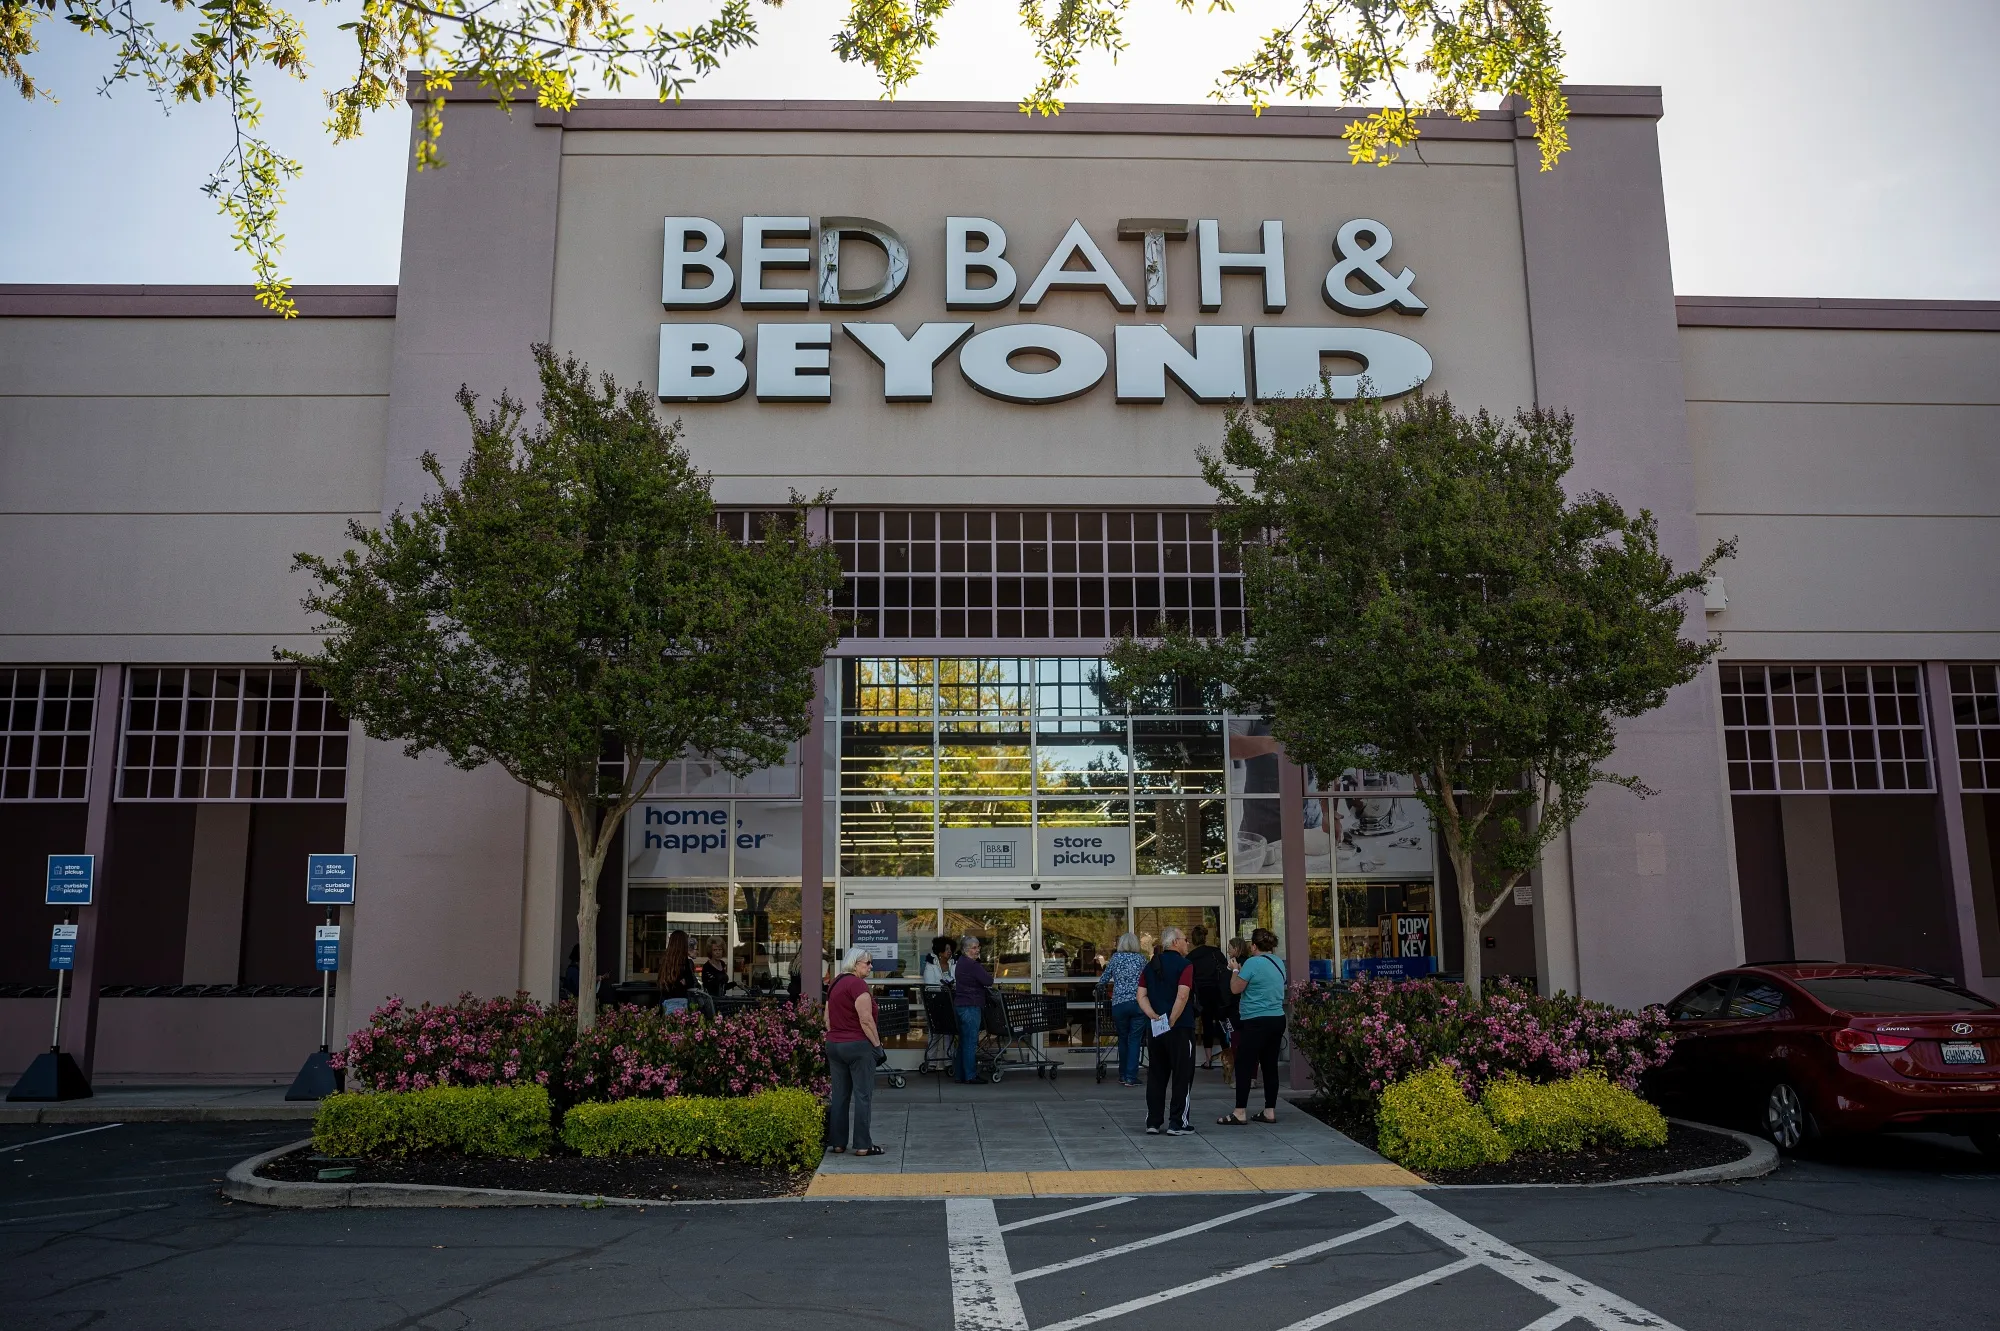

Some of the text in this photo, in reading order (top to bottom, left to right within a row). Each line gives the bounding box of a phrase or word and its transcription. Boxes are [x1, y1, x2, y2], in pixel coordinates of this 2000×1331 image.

[661, 215, 1429, 316] BED BATH &
[657, 321, 1435, 404] BEYOND
[1053, 836, 1103, 848] store
[1053, 850, 1116, 867] pickup
[54, 928, 62, 936] 2
[318, 930, 323, 938] 1
[1398, 918, 1429, 935] COPY
[1401, 940, 1426, 957] KEY
